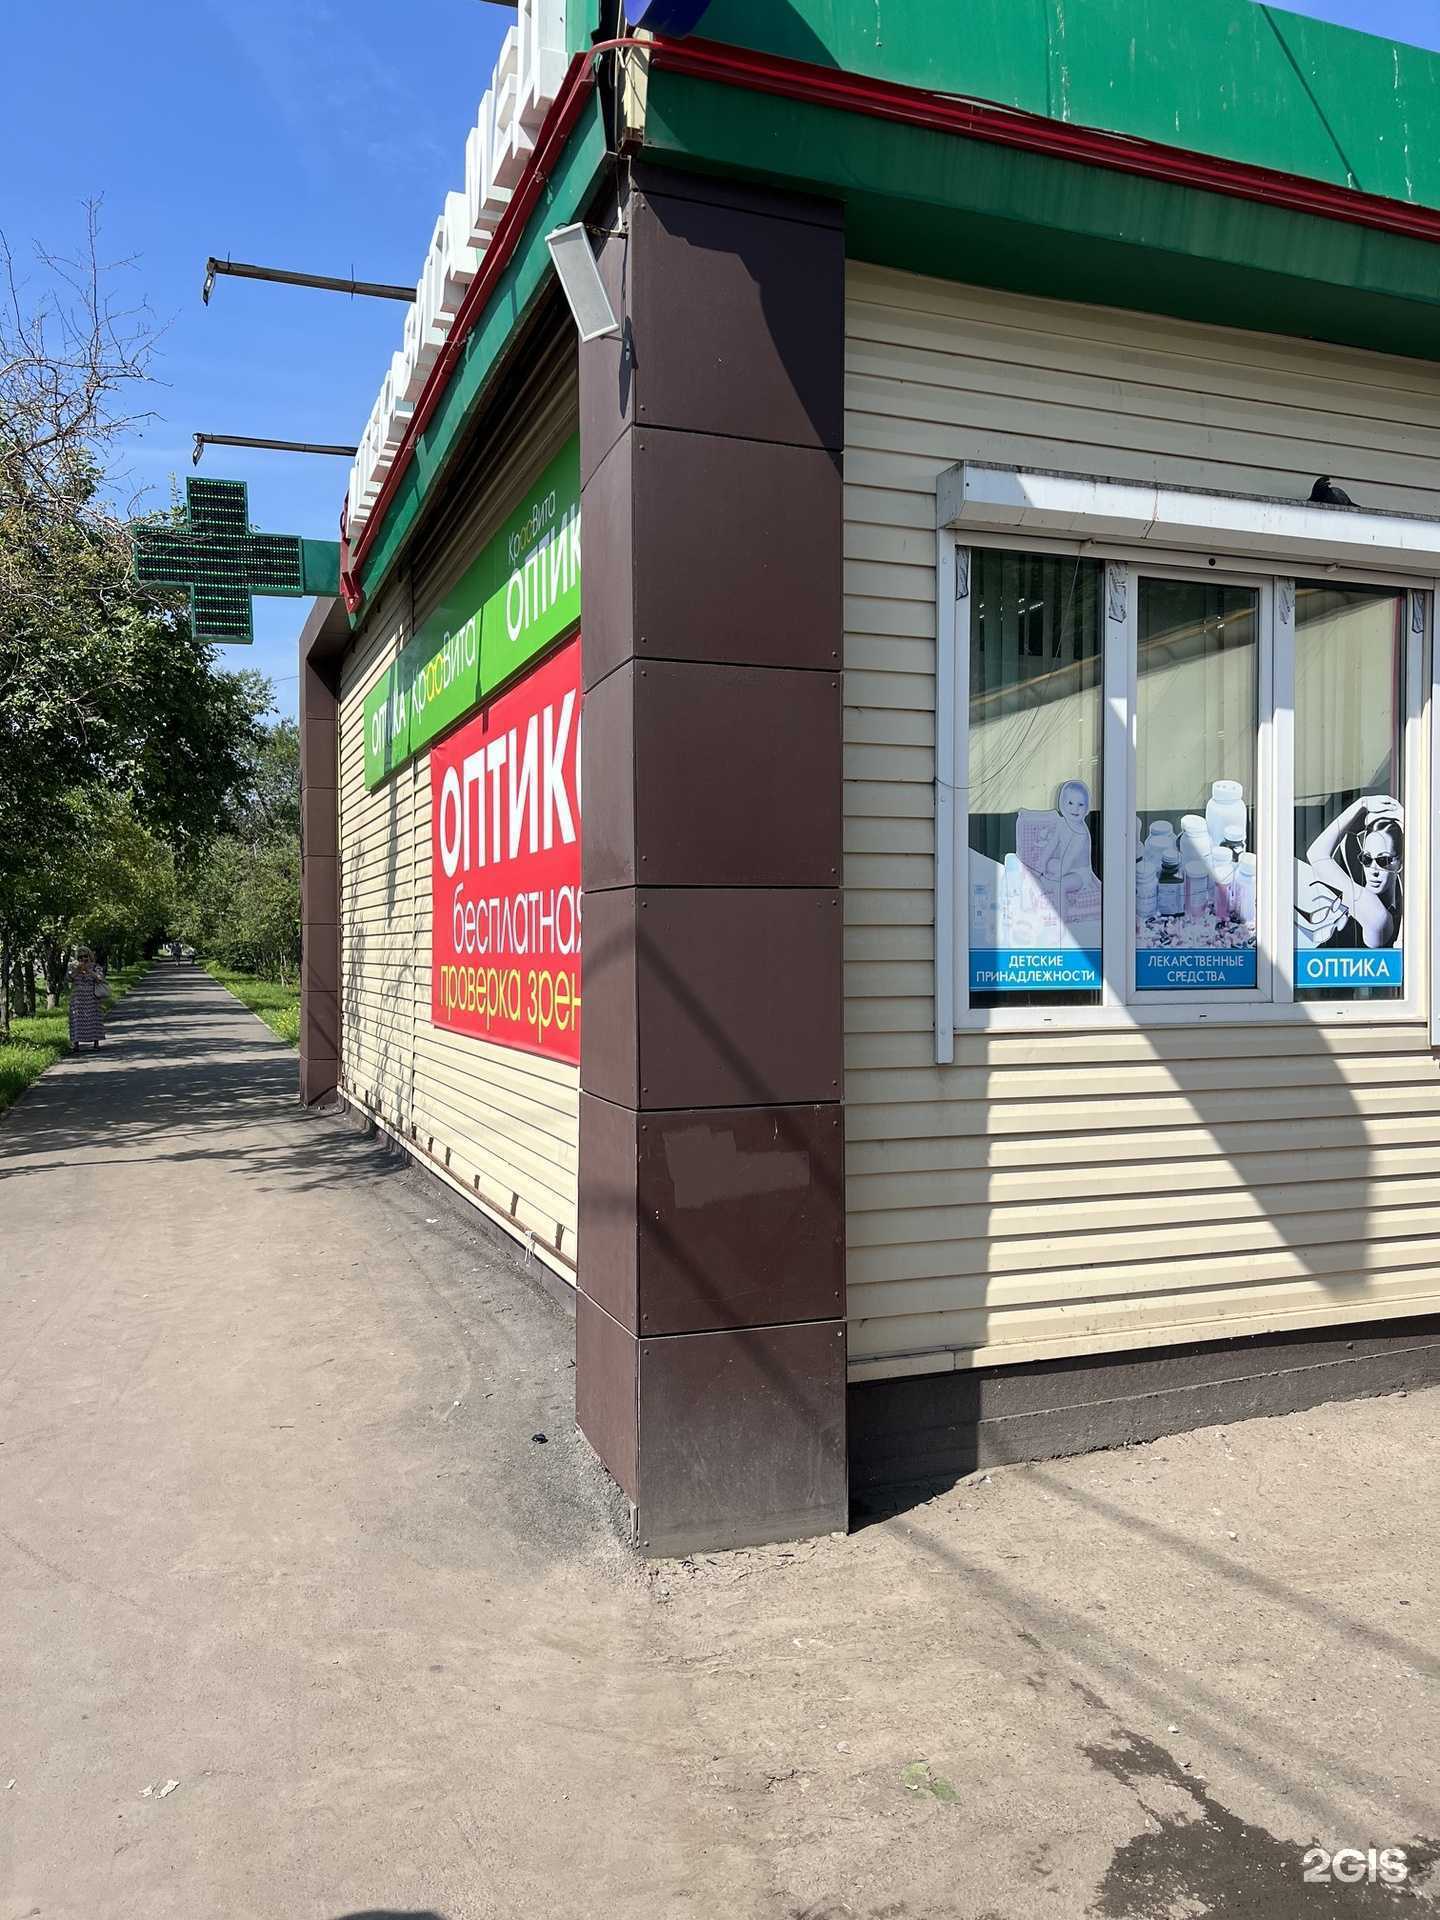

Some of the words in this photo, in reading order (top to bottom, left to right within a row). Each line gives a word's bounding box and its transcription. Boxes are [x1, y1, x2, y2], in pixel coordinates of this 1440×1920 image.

[439, 689, 581, 878] ОПТИК
[1008, 955, 1064, 968] ДЕТСКИЕ
[1148, 955, 1244, 967] ЛЕКАРСТВЕННЫЕ
[1307, 958, 1390, 978] ОПТИКА
[976, 970, 1095, 983] ПРИНАДЛЕЖНОСТИ
[1167, 970, 1226, 983] СРЕДСТВА
[440, 964, 521, 1030] проверка
